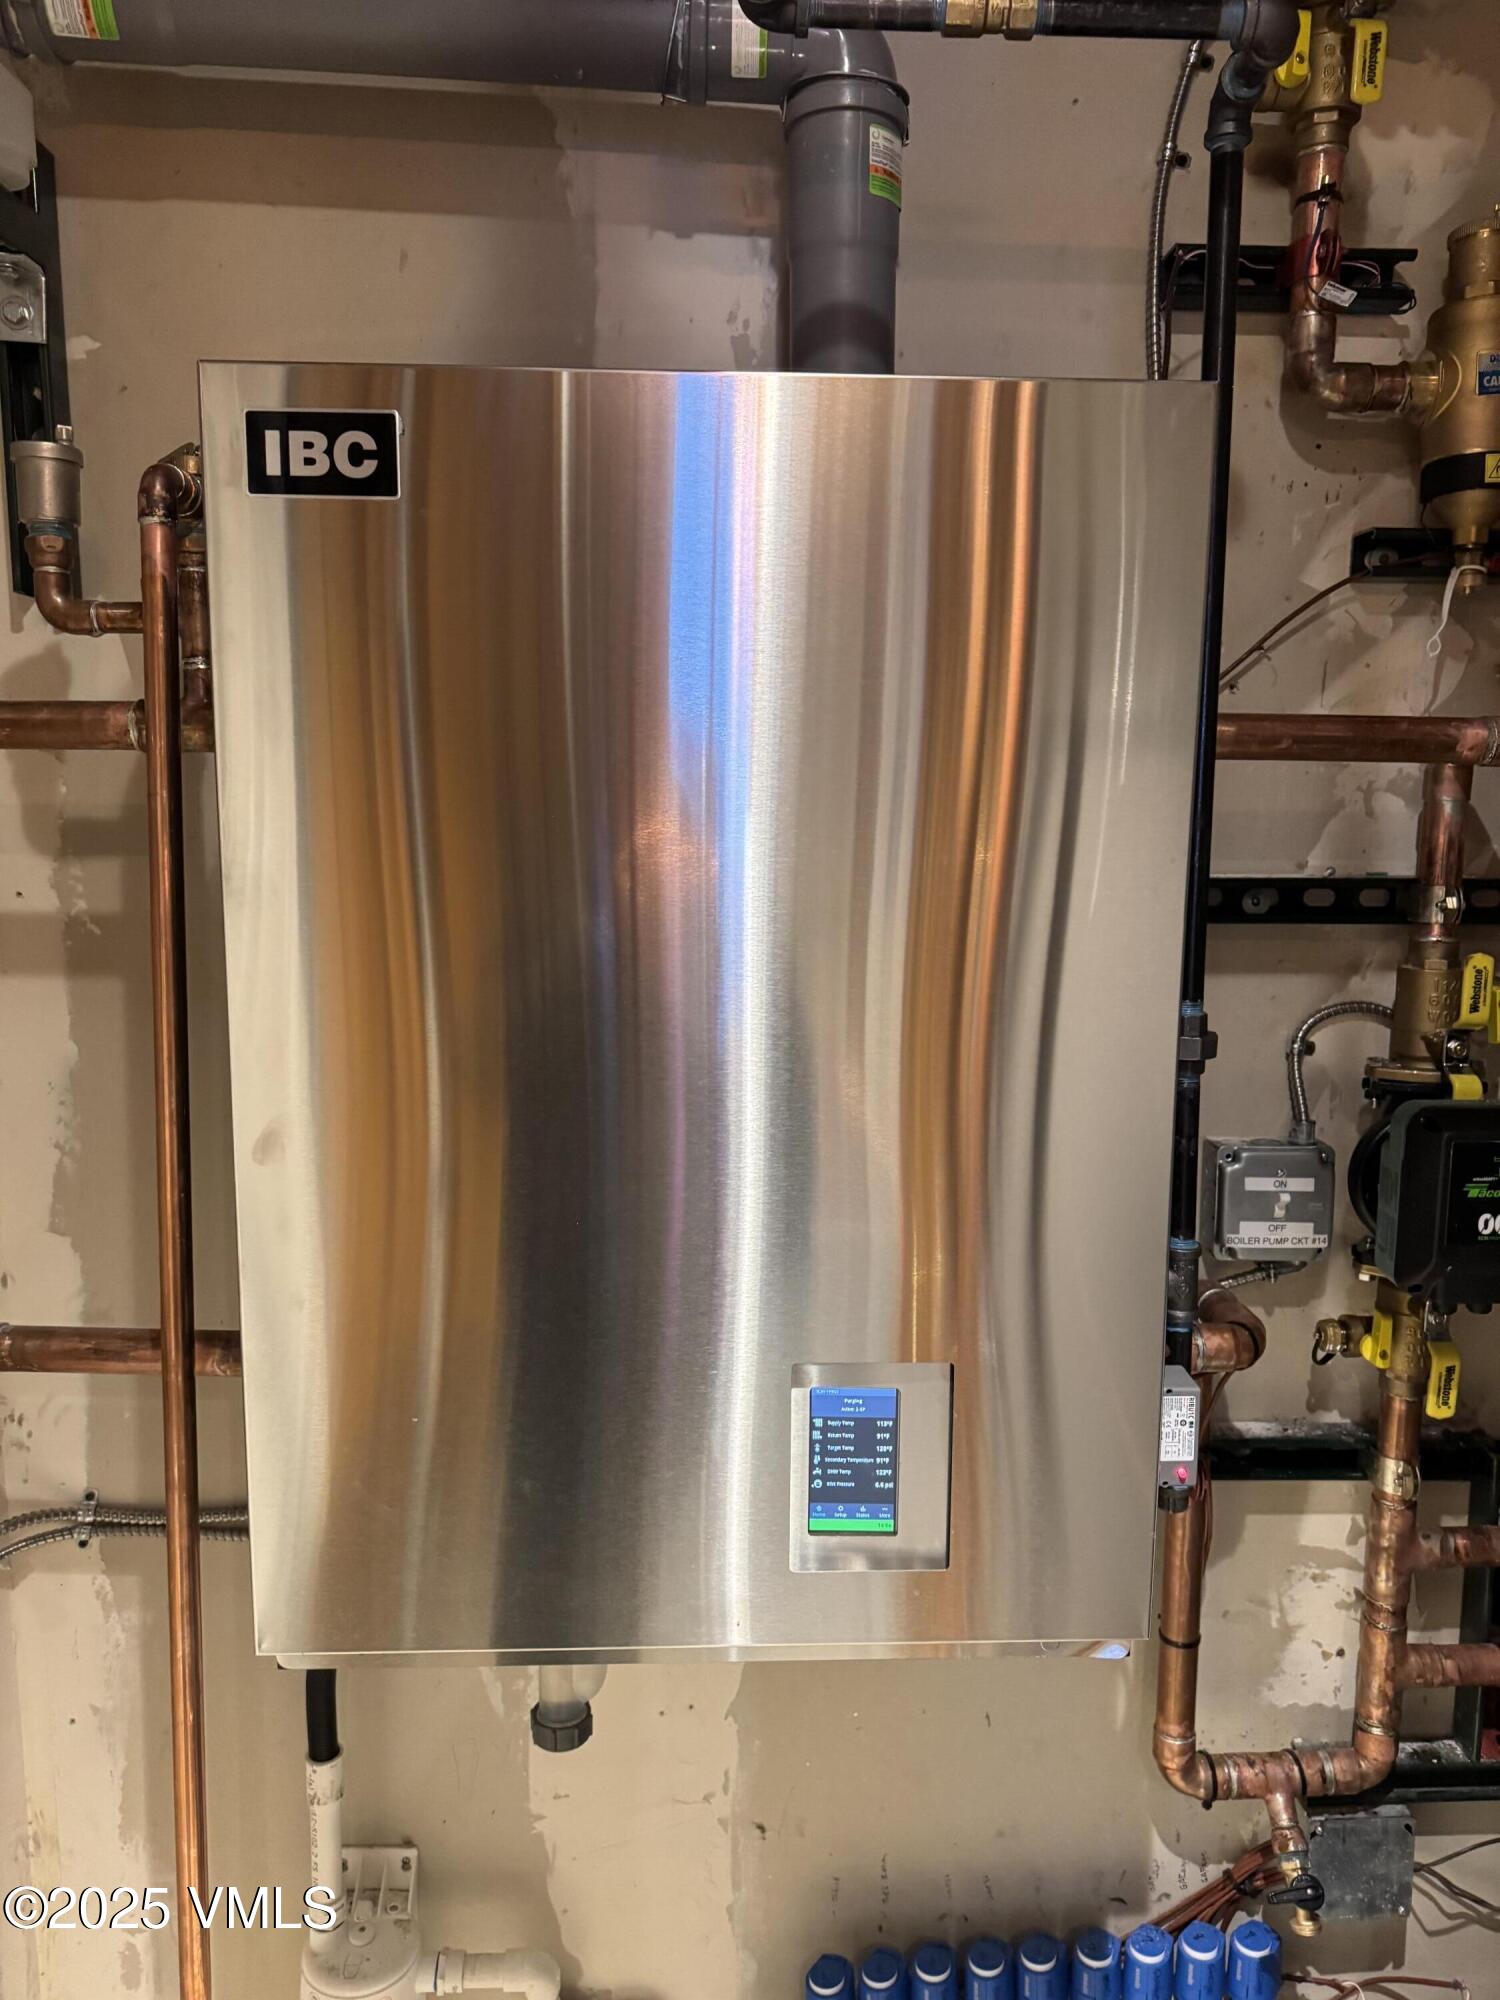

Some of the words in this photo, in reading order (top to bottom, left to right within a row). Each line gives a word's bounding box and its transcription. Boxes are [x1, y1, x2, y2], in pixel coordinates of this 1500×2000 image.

[264, 429, 379, 479] IBC
[1469, 968, 1483, 1014] Webstone
[1273, 1180, 1287, 1188] ON
[1463, 1183, 1500, 1198] Taco
[1268, 1224, 1287, 1232] OFF
[1226, 1237, 1261, 1245] BOILER
[1263, 1237, 1290, 1245] PUMP
[1291, 1237, 1309, 1245] CKT
[1312, 1237, 1327, 1245] #14
